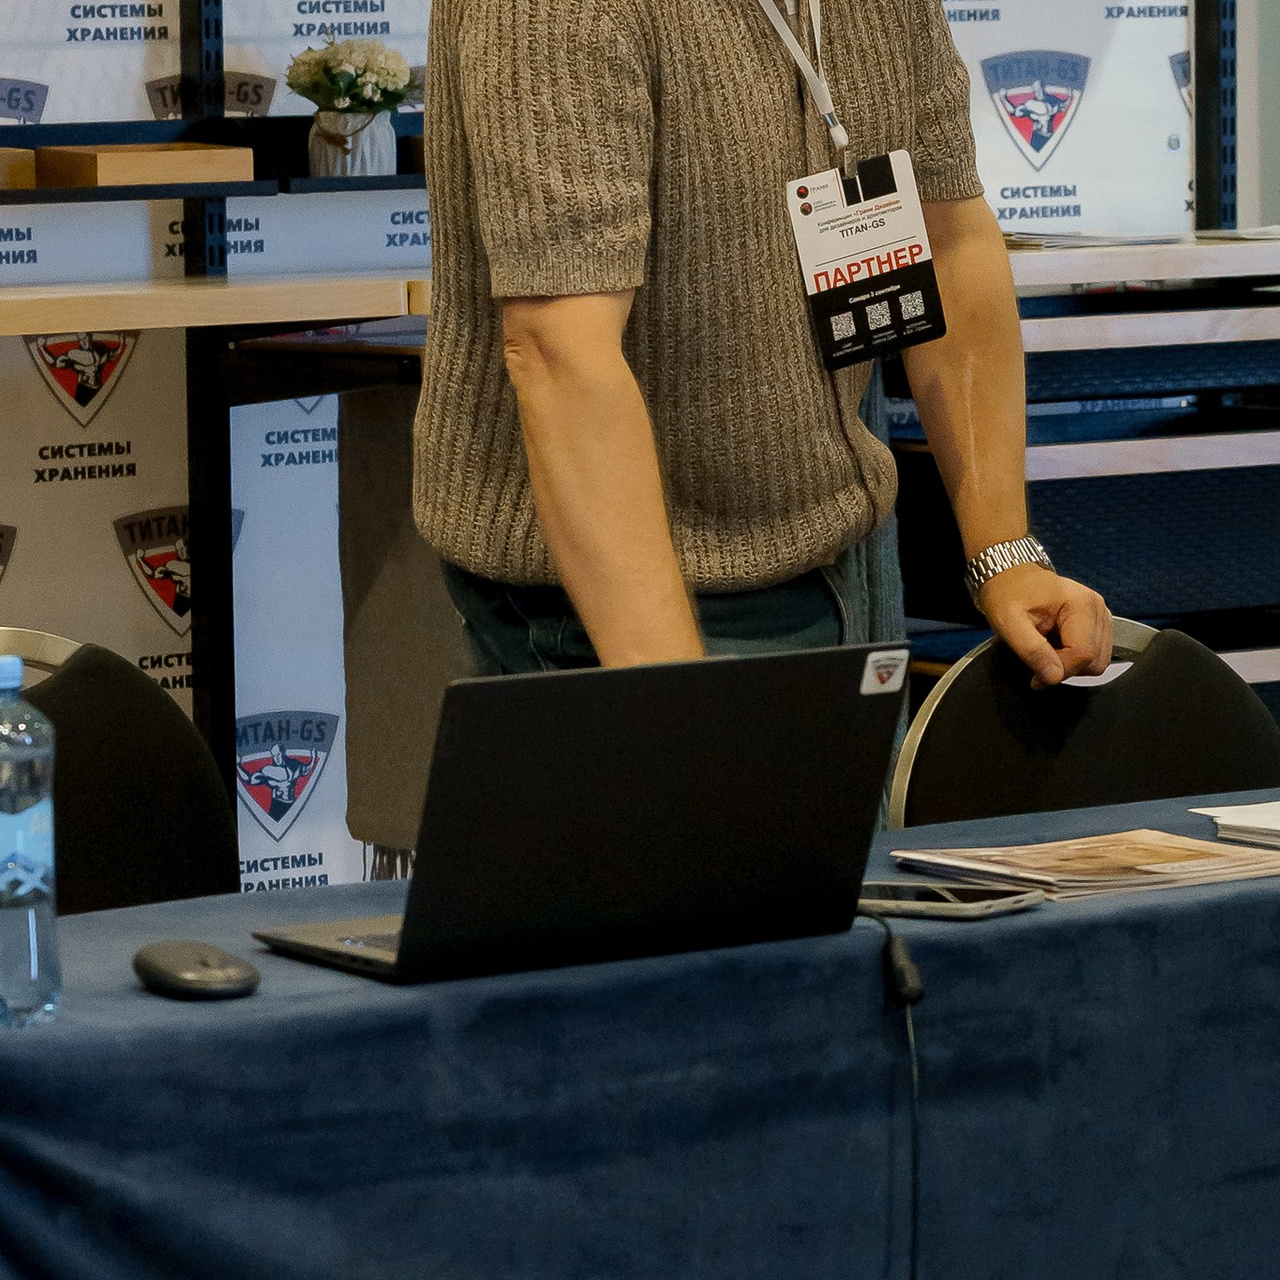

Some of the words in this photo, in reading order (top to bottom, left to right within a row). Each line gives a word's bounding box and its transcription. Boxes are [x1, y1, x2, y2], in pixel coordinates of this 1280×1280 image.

[70, 4, 163, 19] СИСТЕМЫ
[296, 0, 385, 14] СИСТЕМЫ
[948, 9, 1000, 22] НЕНИЯ
[1105, 5, 1188, 19] ХРАНЕНИЯ
[66, 26, 169, 41] ХРАНЕНИЯ
[292, 21, 390, 37] ХРАНЕНИЯ
[1000, 185, 1077, 200] СИСТЕМЫ
[997, 204, 1081, 220] ХРАНЕНИЯ
[839, 218, 886, 238] TITAN-GS
[813, 243, 924, 293] ПАРТНЕР
[265, 427, 337, 445] СИСТЕМ
[38, 441, 132, 460] СИСТЕМЫ
[261, 450, 338, 468] ХРАНЕН
[34, 463, 136, 483] ХРАНЕНИЯ
[138, 653, 193, 670] СИСТЕ
[236, 720, 327, 748] ИТАН-GS
[242, 874, 329, 893] РАНЕНИЯ
